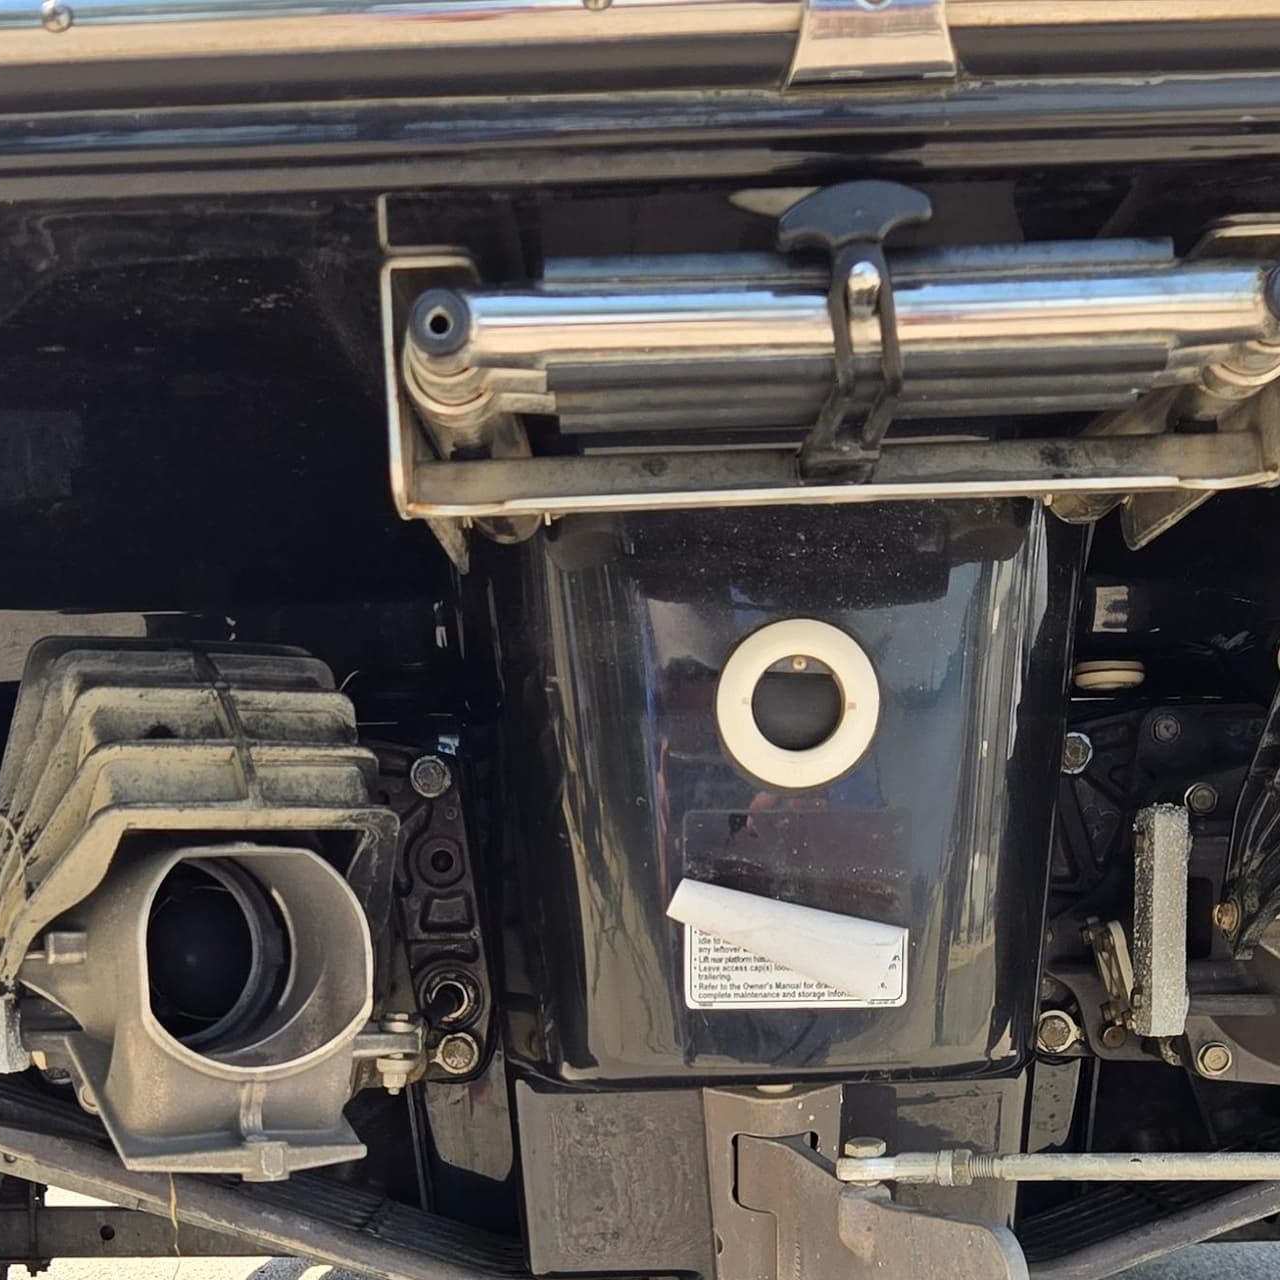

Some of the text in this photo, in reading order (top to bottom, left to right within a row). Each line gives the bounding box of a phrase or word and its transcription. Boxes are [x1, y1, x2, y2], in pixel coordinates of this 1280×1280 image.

[724, 955, 753, 964] platform
[698, 964, 720, 972] Leave
[698, 982, 718, 990] Refer
[719, 982, 728, 990] to
[729, 982, 741, 990] the
[742, 981, 773, 990] Owner's
[775, 981, 802, 990] Manual
[803, 981, 814, 989] for
[698, 992, 732, 1000] complete
[733, 991, 780, 999] maintenance
[782, 991, 796, 999] and
[797, 990, 826, 999] storage
